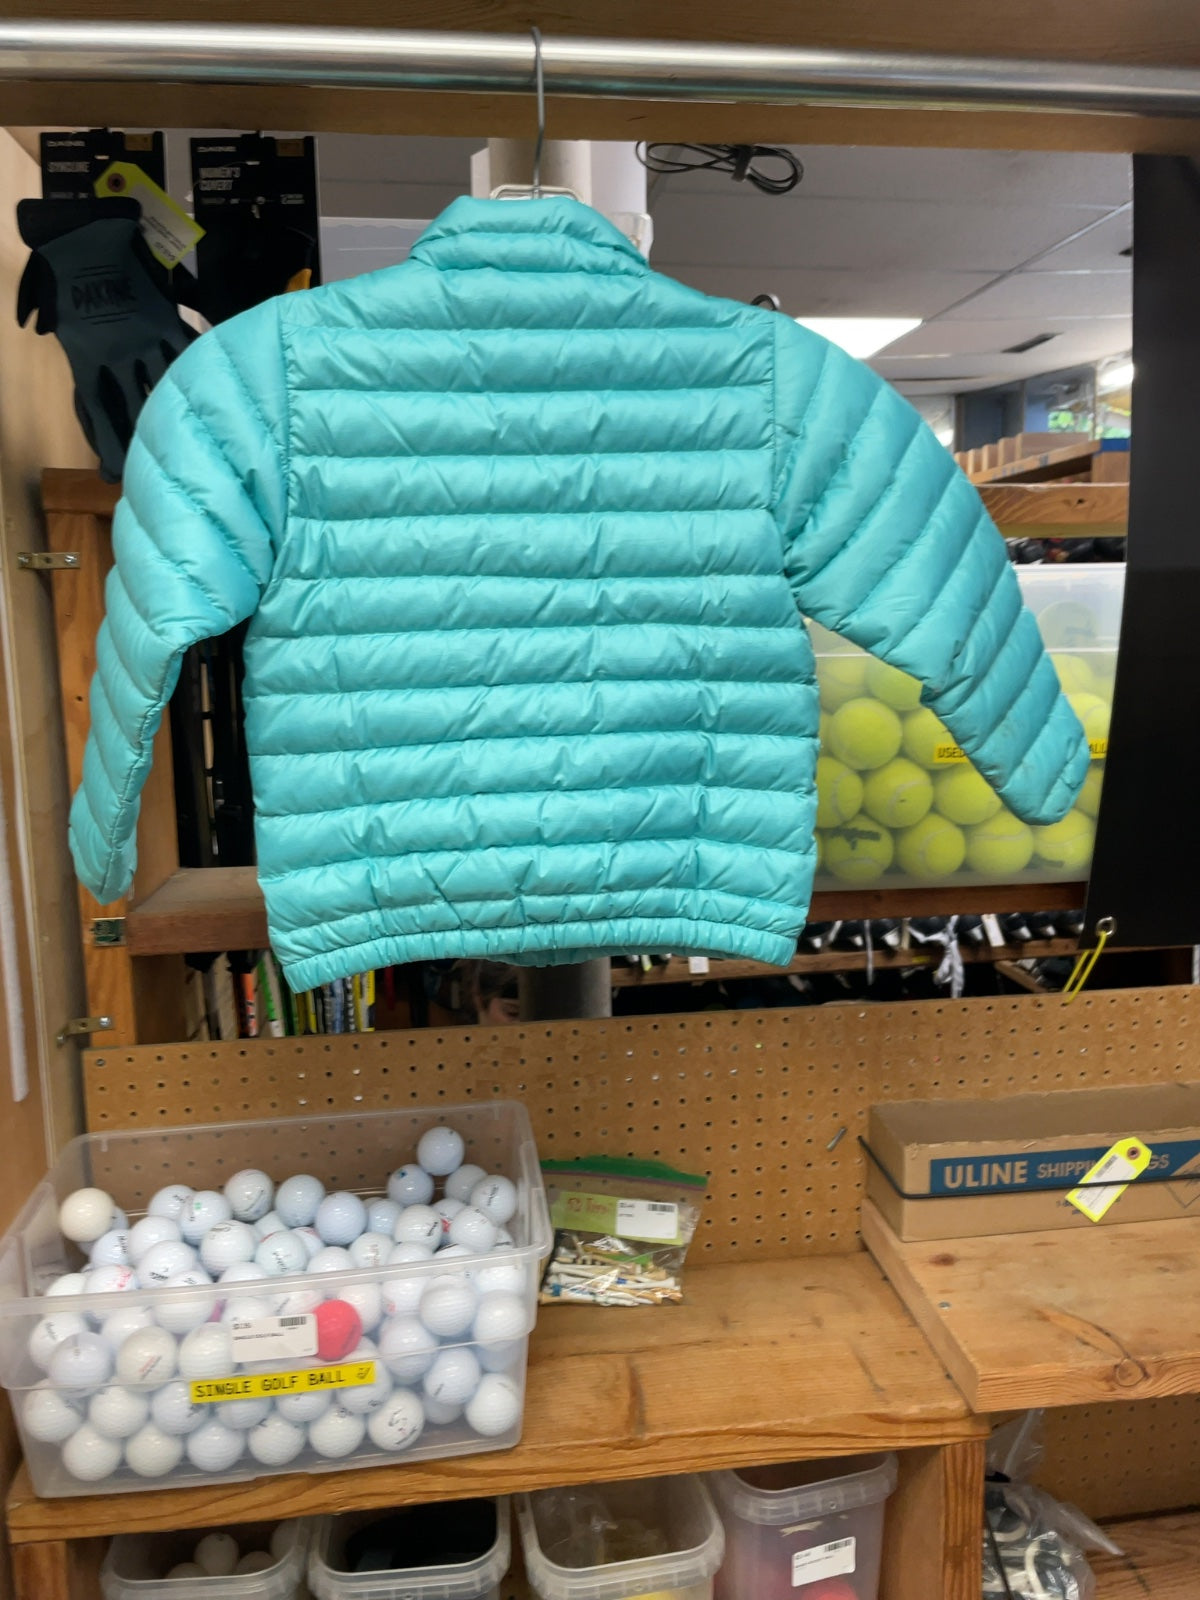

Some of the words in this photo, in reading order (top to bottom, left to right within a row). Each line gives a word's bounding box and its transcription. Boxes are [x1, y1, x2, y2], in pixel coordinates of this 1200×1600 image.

[199, 167, 241, 178] WOMEN'S
[943, 1160, 1029, 1189] ULINE
[195, 1380, 253, 1397] SINGLE
[261, 1375, 299, 1391] GOLF
[307, 1370, 347, 1385] BALL
